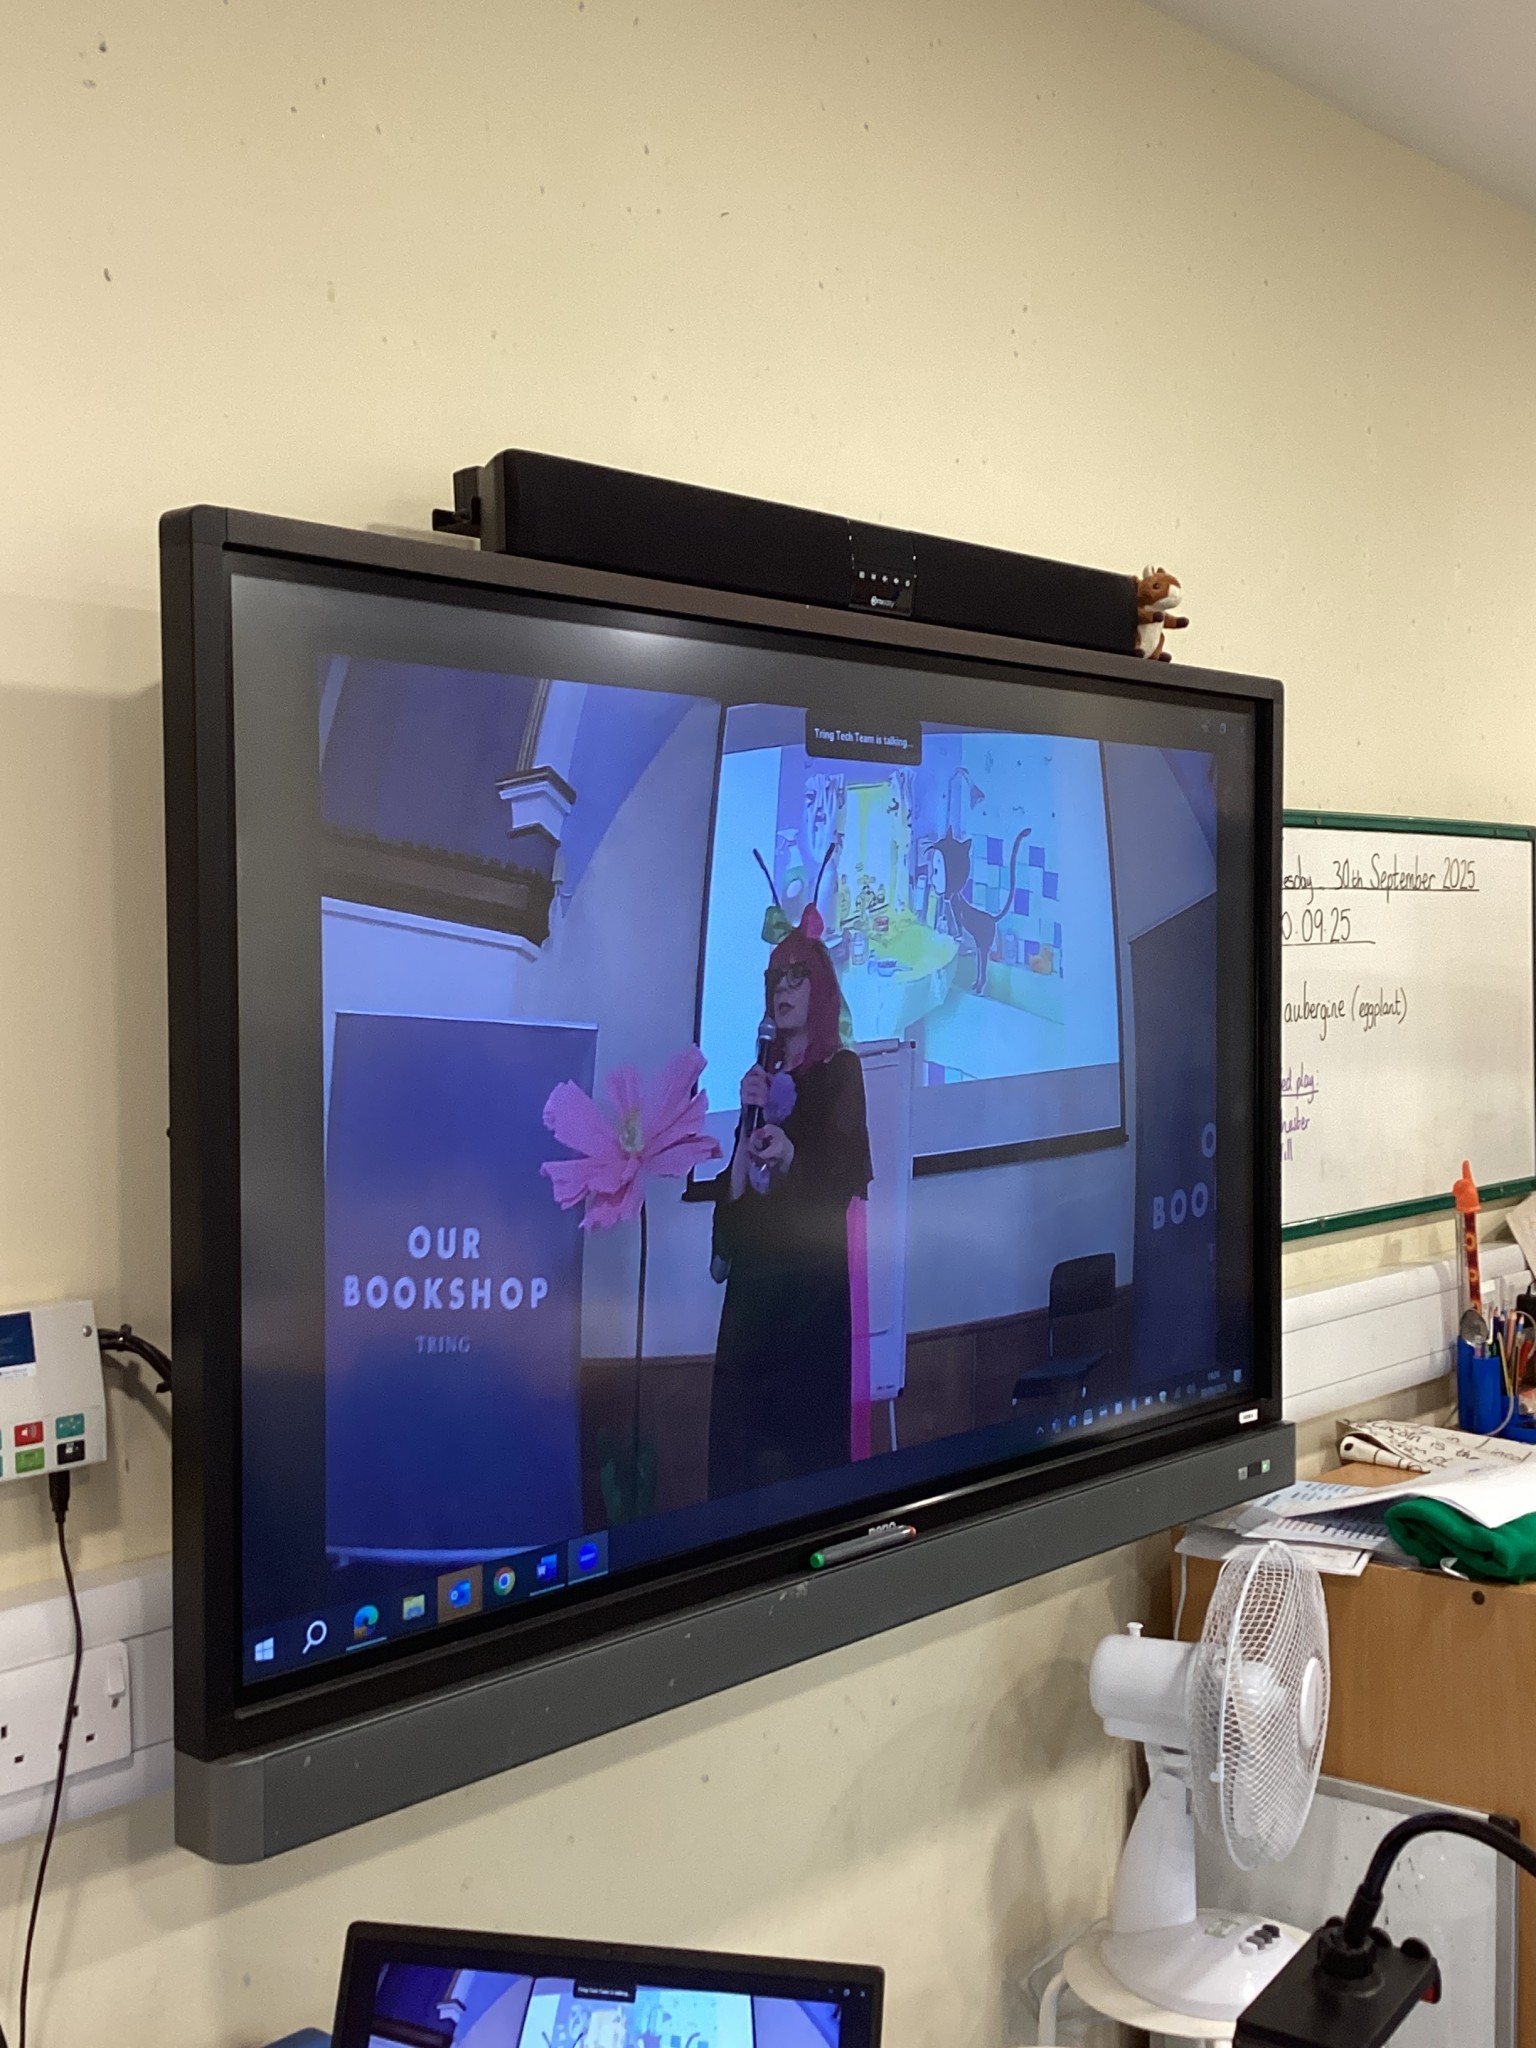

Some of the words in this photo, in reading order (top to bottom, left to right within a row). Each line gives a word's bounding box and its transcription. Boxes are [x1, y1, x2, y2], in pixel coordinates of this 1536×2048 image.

[814, 727, 835, 742] Tring
[836, 730, 854, 742] Tech
[854, 732, 875, 744] Team
[876, 735, 883, 745] is
[1370, 852, 1436, 904] September
[1442, 856, 1476, 890] 2025
[1284, 980, 1346, 1041] aubergine
[1352, 984, 1407, 1033] (eggplant)
[1201, 1122, 1217, 1158] O
[1152, 1182, 1216, 1230] BOO
[407, 1225, 481, 1260] OUR
[342, 1274, 549, 1311] BOOKSHOP
[415, 1335, 472, 1354] TRING
